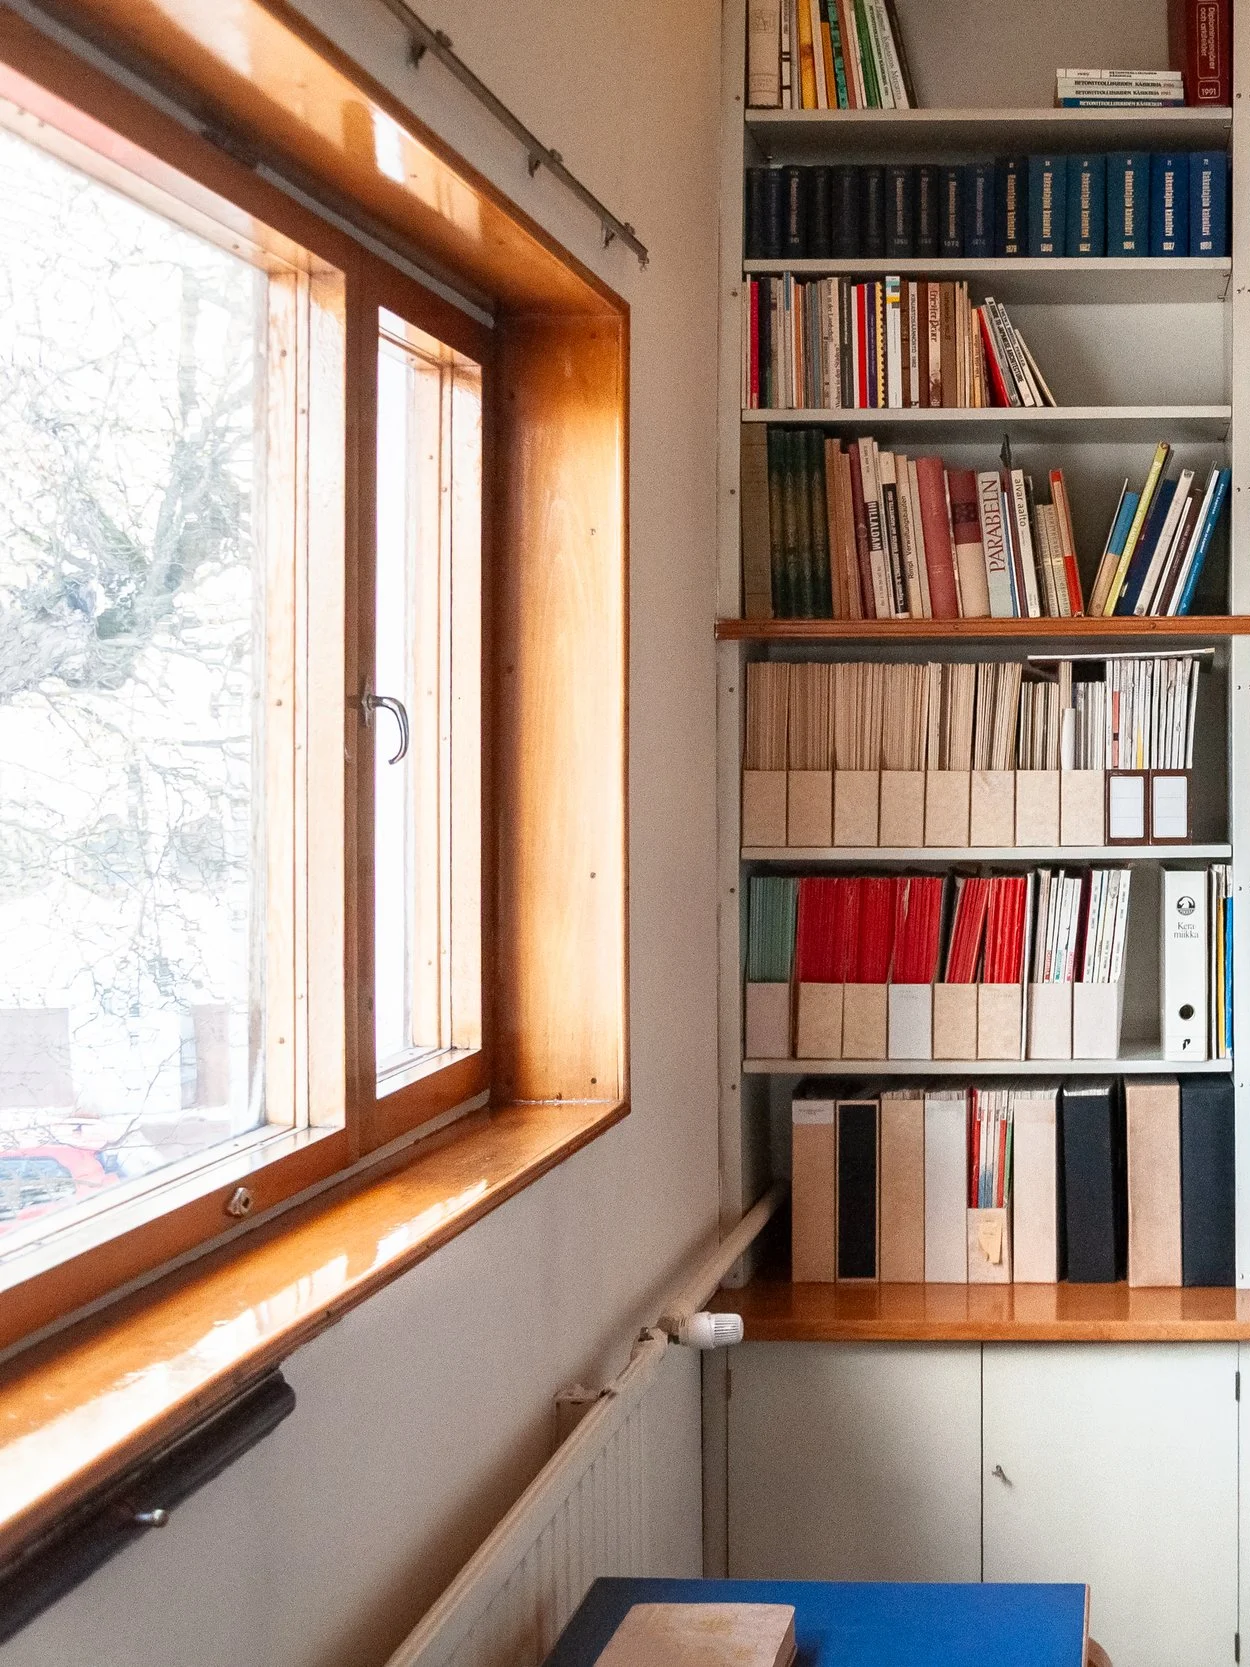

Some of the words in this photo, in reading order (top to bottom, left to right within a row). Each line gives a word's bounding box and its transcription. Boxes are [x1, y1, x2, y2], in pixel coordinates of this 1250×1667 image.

[1202, 87, 1217, 96] 1991
[1201, 171, 1212, 207] Rakentajain
[1202, 208, 1211, 236] kalenteri
[1006, 349, 1025, 384] ARCHITECTURE
[1013, 478, 1024, 502] alvar
[867, 502, 882, 550] HILLALDAM
[900, 495, 912, 556] Verwaltungsbauten
[981, 480, 1006, 573] PARABELN
[1016, 503, 1028, 527] aalto
[907, 560, 915, 579] Rimpl
[1173, 930, 1199, 939] miikka
[1177, 921, 1195, 930] Kera
